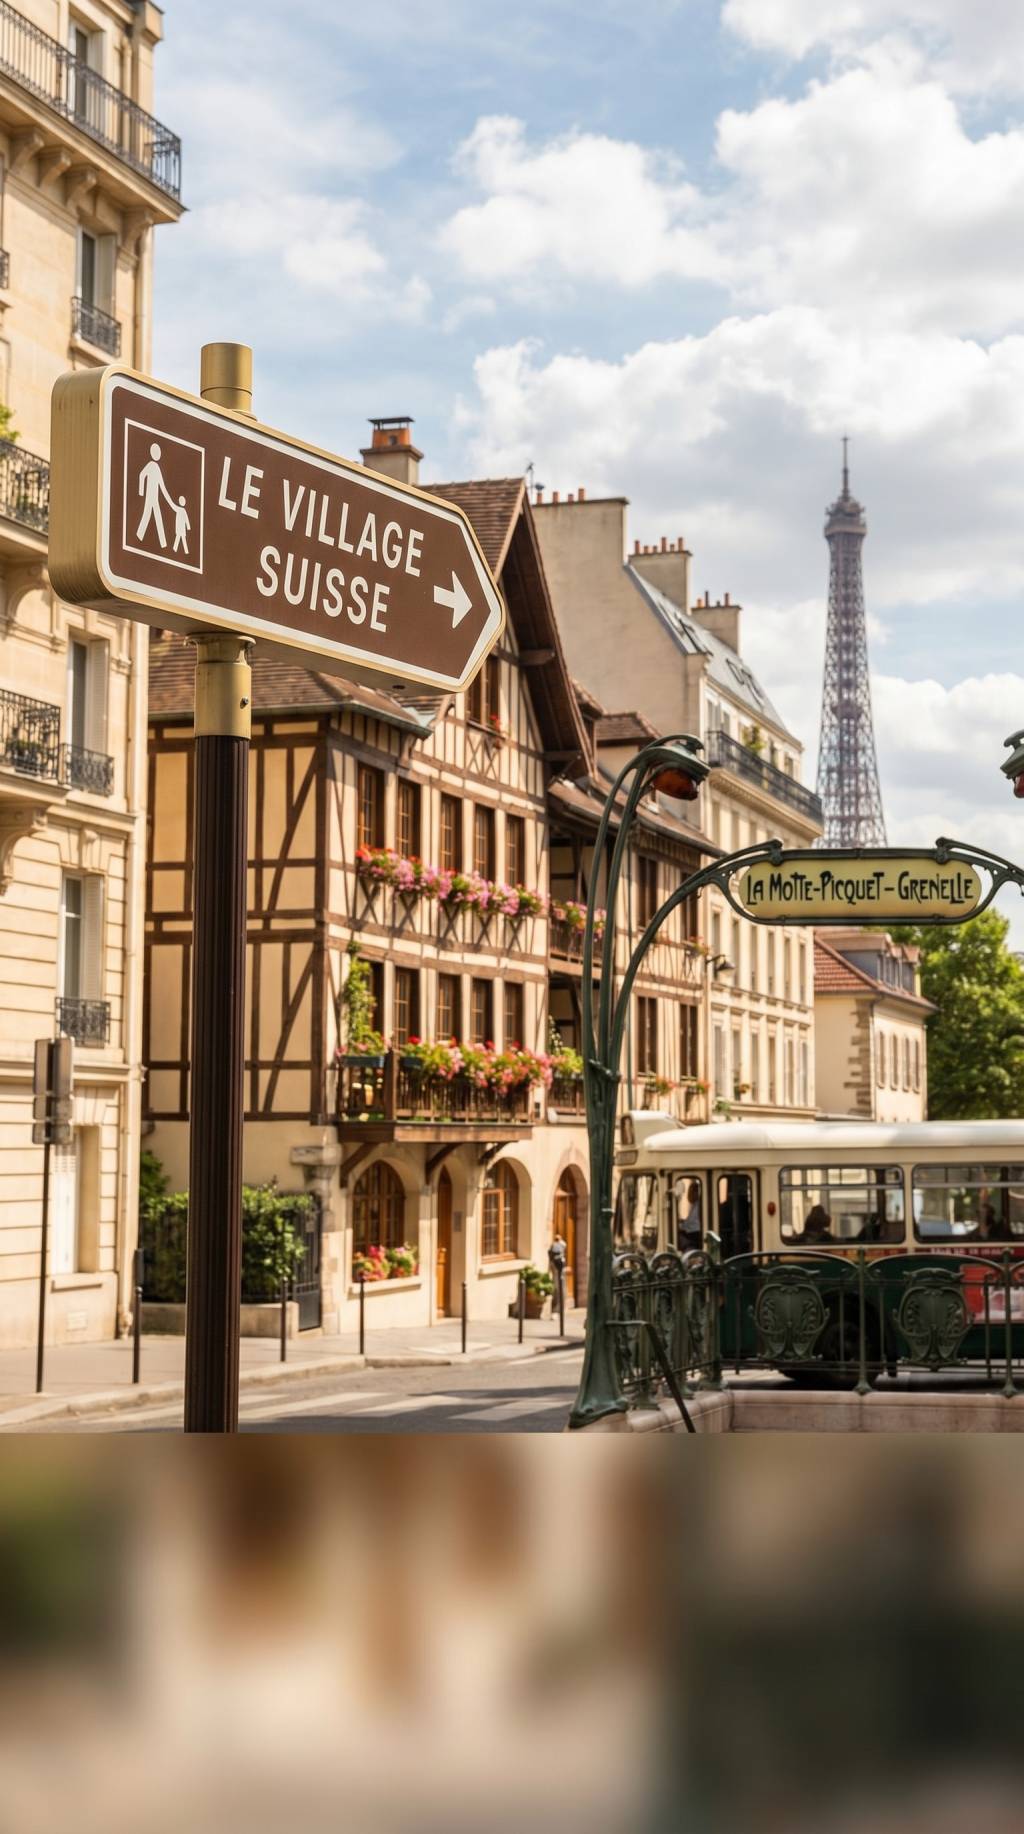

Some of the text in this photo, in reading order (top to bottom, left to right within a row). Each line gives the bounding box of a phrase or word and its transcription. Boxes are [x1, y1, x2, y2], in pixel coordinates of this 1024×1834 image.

[218, 456, 424, 577] LE VILLAGE
[256, 545, 391, 633] SUISSE
[746, 874, 764, 905] LA
